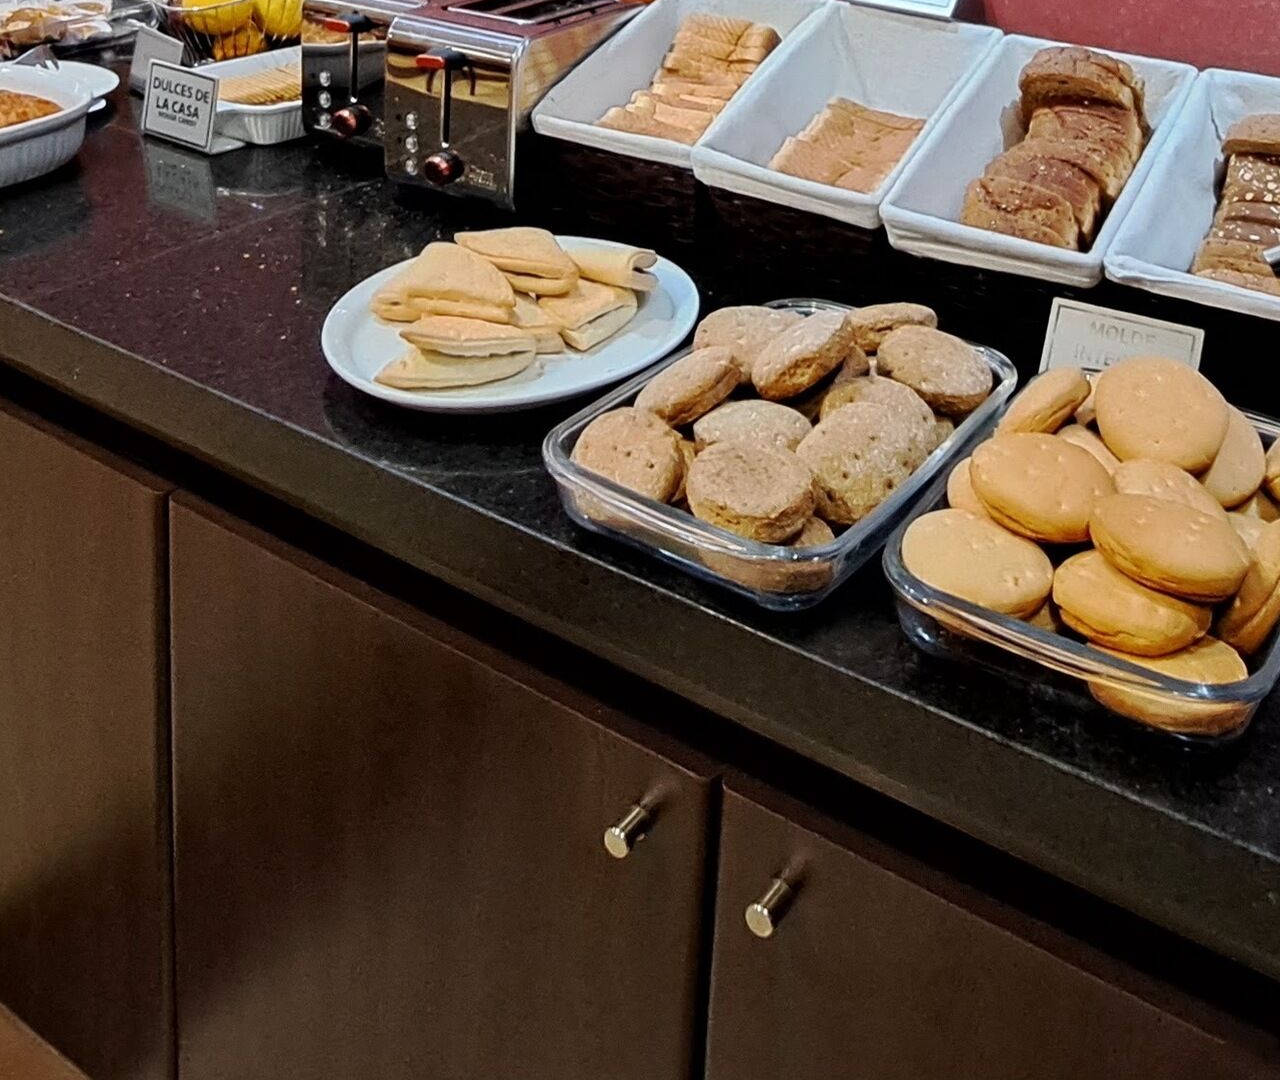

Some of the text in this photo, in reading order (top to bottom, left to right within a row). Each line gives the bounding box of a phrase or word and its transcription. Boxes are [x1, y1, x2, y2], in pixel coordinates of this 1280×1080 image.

[153, 76, 210, 104] DULCES DE
[156, 96, 169, 111] LA
[171, 100, 200, 120] CASA
[1090, 321, 1156, 346] MOLDE
